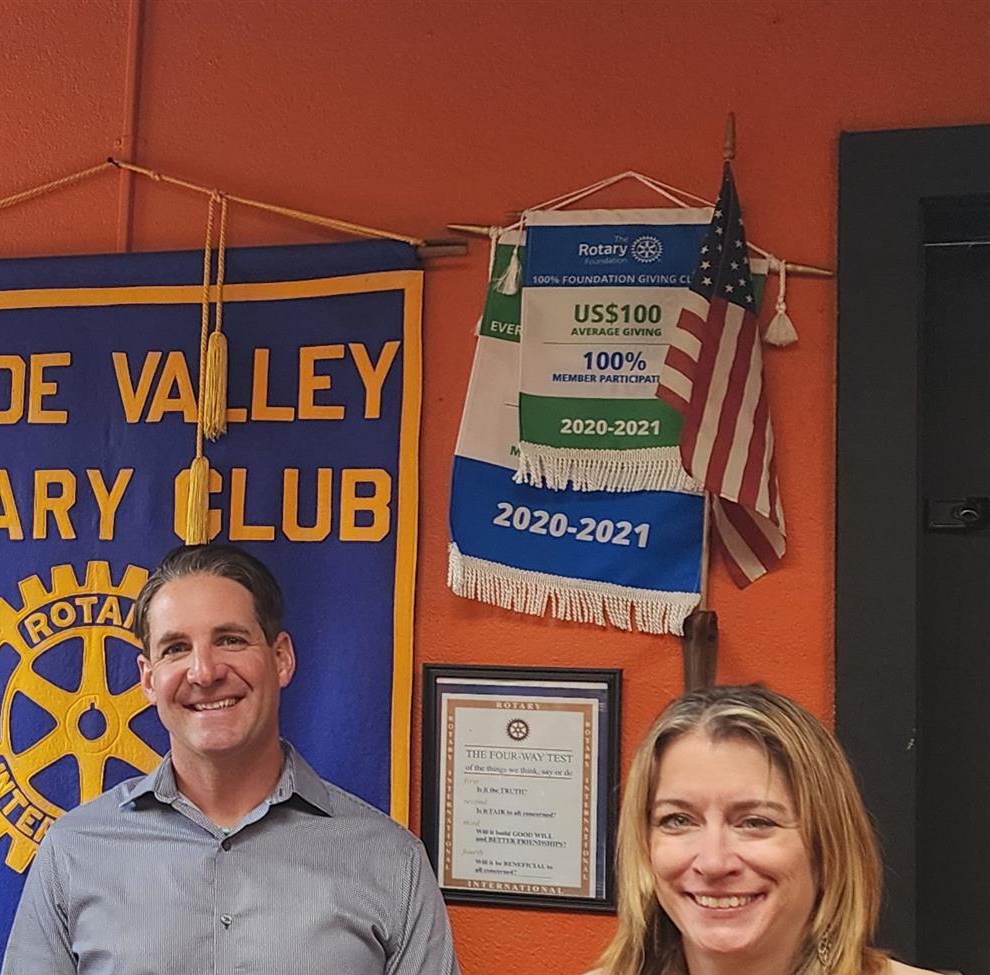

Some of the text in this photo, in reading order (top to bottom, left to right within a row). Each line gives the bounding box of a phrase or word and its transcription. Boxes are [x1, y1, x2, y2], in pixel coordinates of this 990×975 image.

[578, 243, 628, 257] Rotary
[584, 256, 628, 265] Foundation
[532, 275, 560, 284] 100%
[562, 275, 635, 285] FOUNDATION
[638, 274, 677, 284] GIVING
[574, 301, 662, 325] US$100
[570, 327, 662, 337] AVERAGE GIVING
[583, 351, 647, 371] 100%
[552, 373, 597, 383] MEMBER
[560, 418, 660, 435] 2020-2021
[493, 502, 650, 548] 2020-2021
[496, 701, 541, 710] ROTARY
[466, 749, 573, 763] THE FOUR-WAY TEST
[474, 764, 485, 772] the
[486, 766, 507, 775] things
[512, 830, 533, 838] GOOD
[466, 880, 564, 895] INTERNATIONAL
